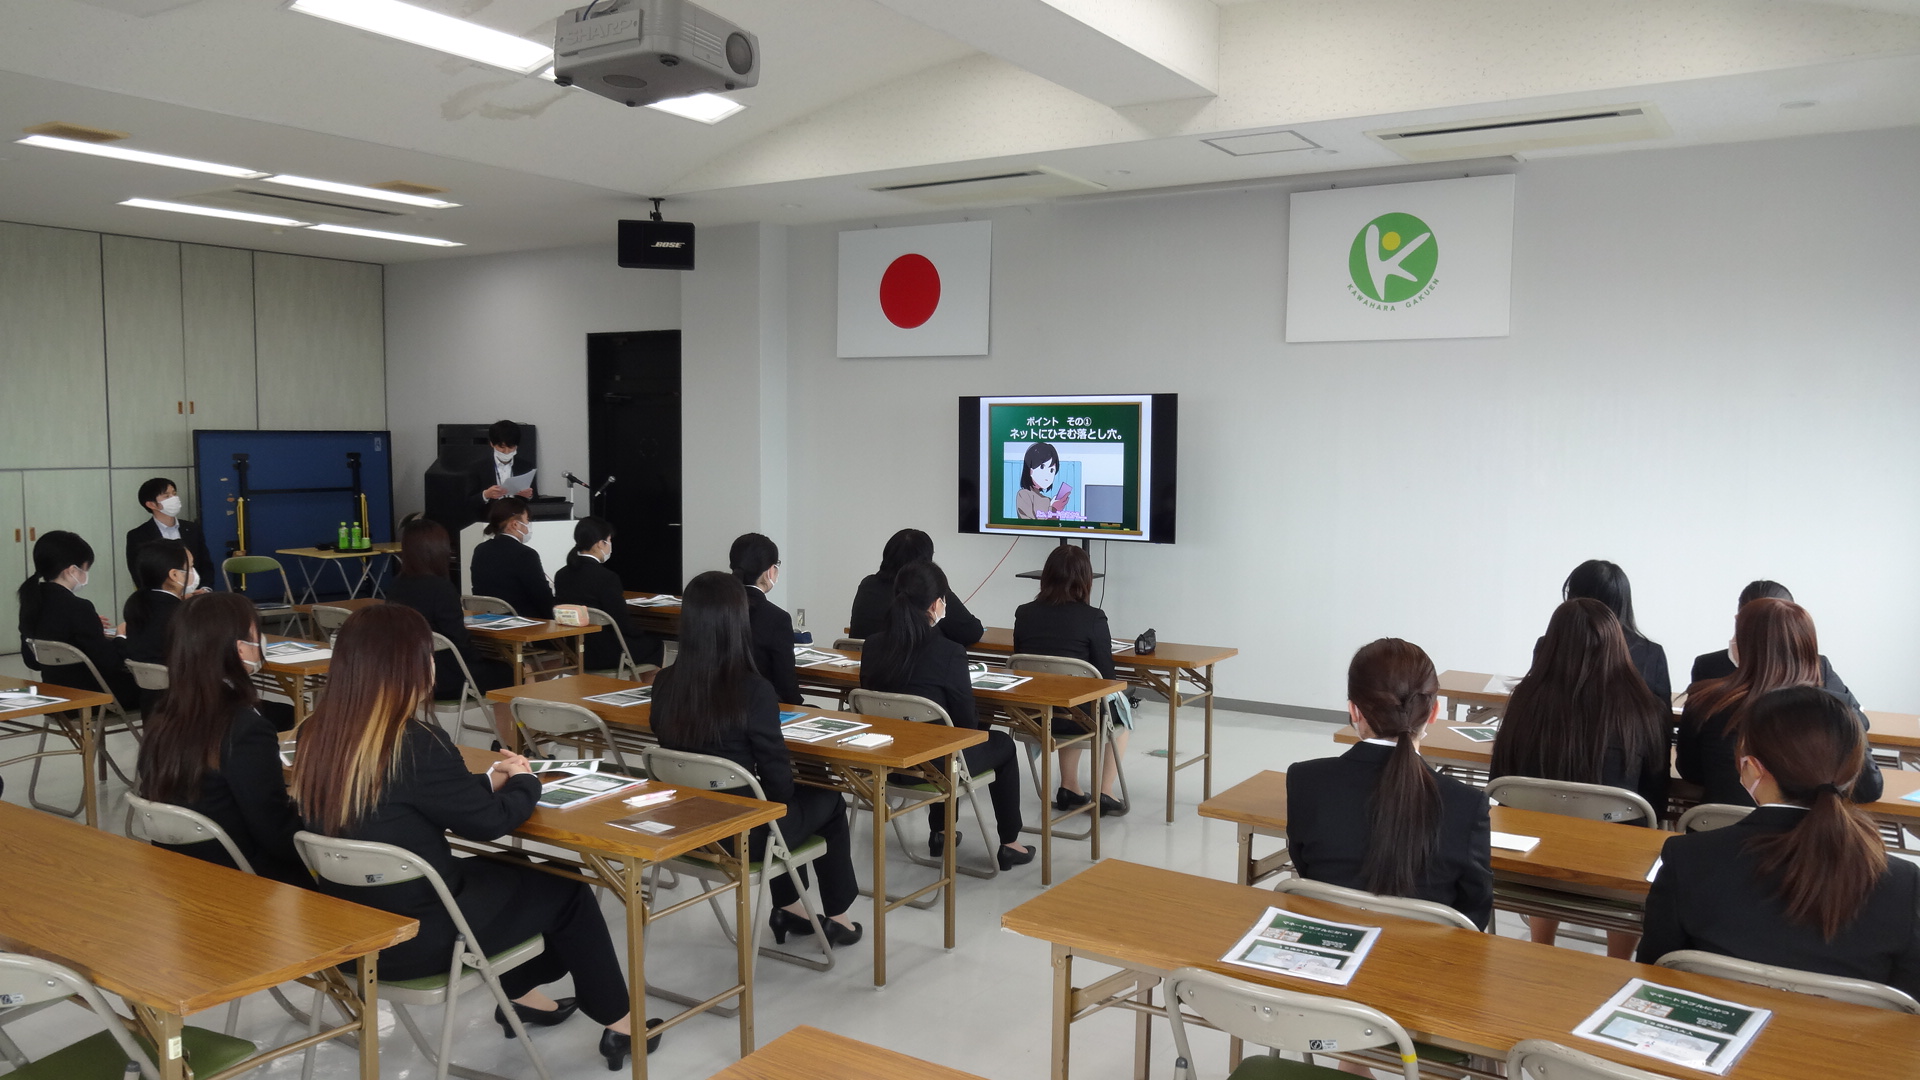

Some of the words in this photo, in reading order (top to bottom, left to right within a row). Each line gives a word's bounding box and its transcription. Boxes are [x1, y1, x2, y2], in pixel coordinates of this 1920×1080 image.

[566, 18, 633, 47] SHARP
[651, 241, 686, 249] BOSE
[1346, 283, 1396, 311] KAWAHARA
[1405, 278, 1440, 308] GAKUEN
[1026, 416, 1060, 427] ポイント
[1009, 428, 1123, 440] ネットにひそむ落とし穴。
